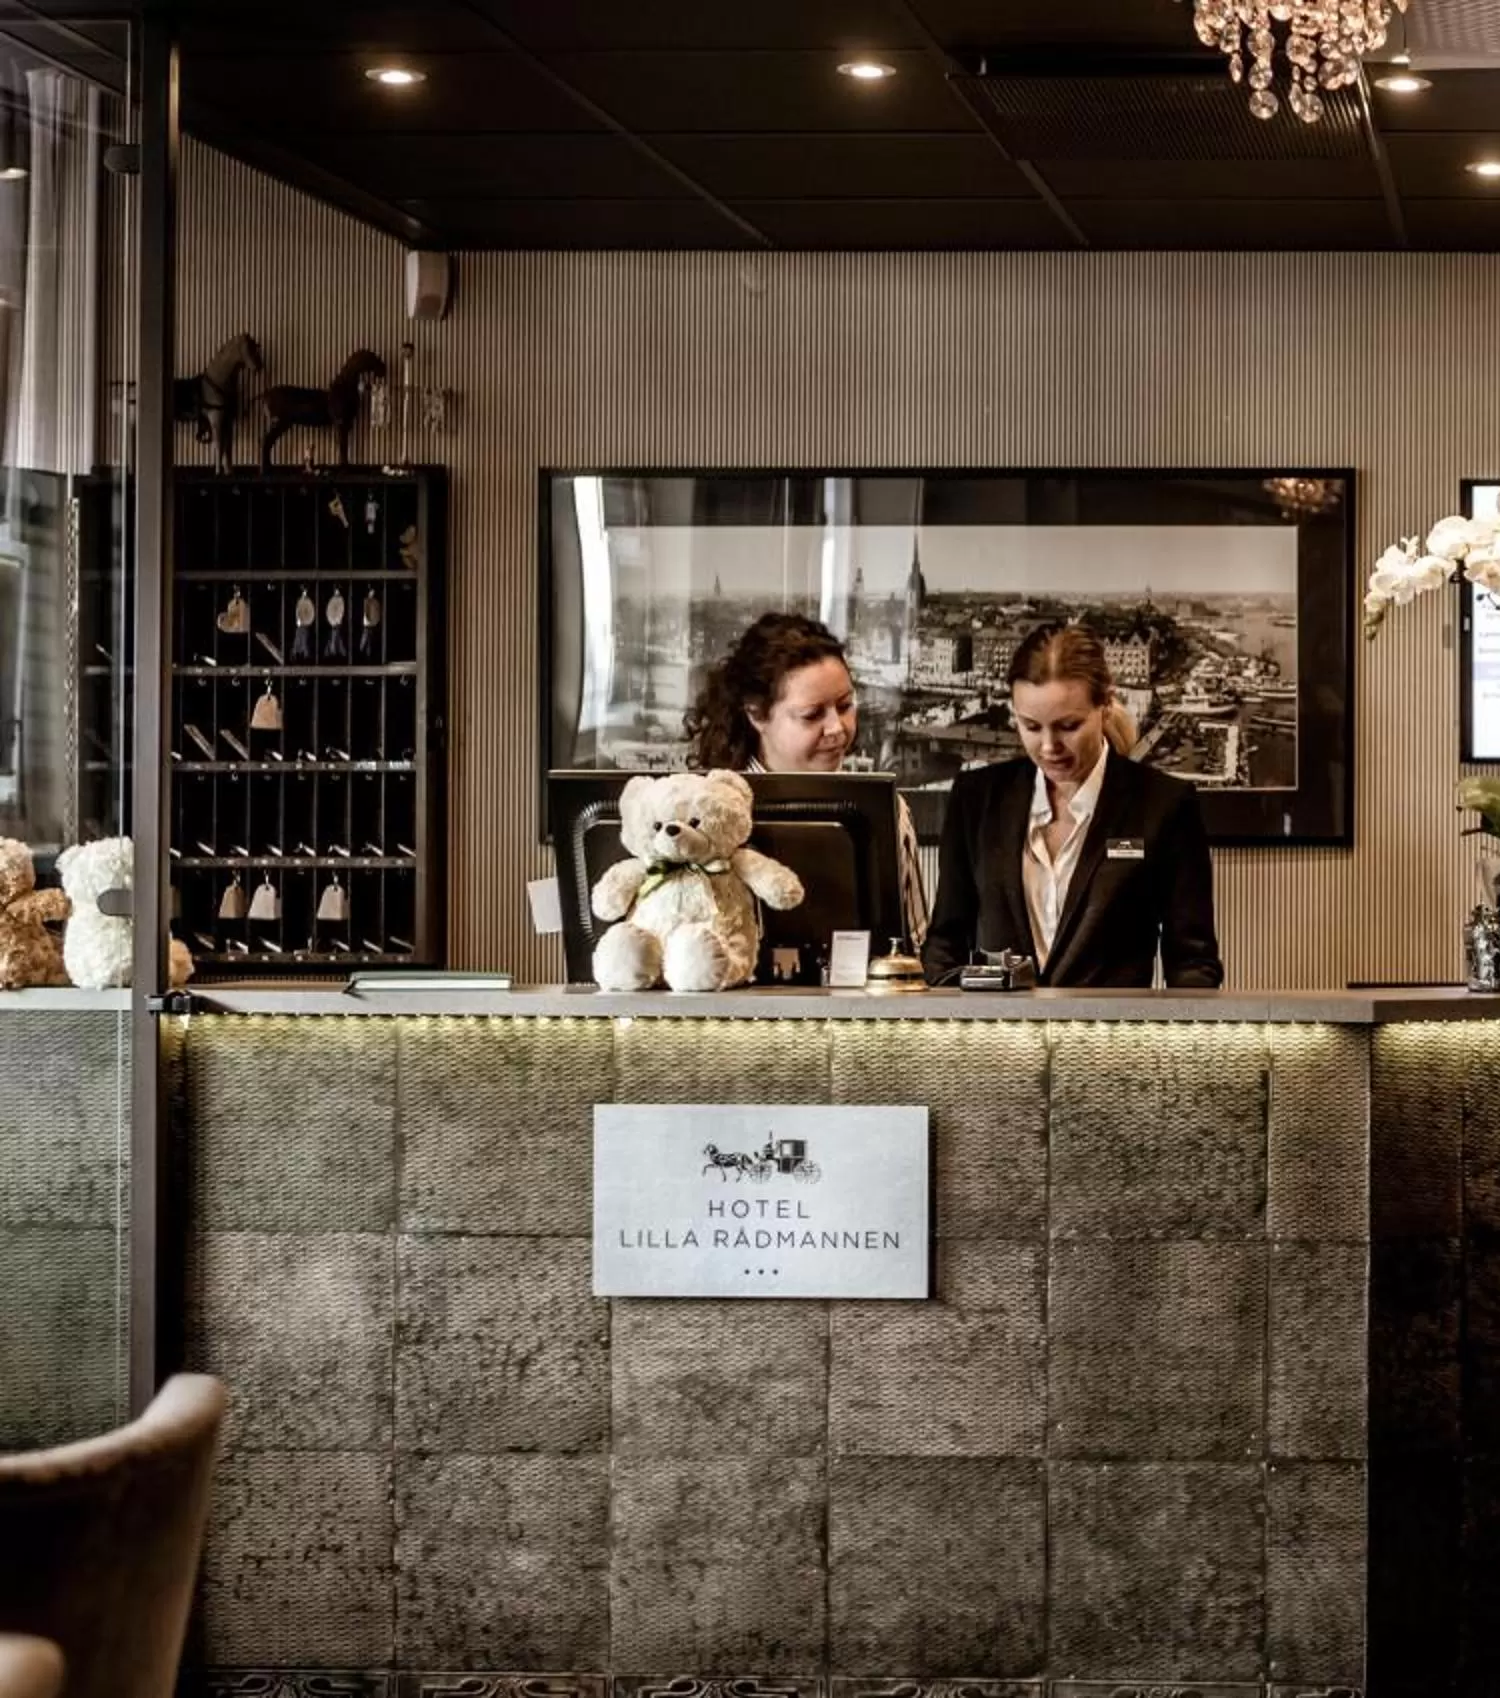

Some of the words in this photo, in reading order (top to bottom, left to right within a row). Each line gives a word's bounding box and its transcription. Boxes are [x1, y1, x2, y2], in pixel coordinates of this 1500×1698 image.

[708, 1199, 811, 1219] HOTEL
[620, 1229, 700, 1249] LILLA
[713, 1226, 900, 1249] RÅDMANNEN
